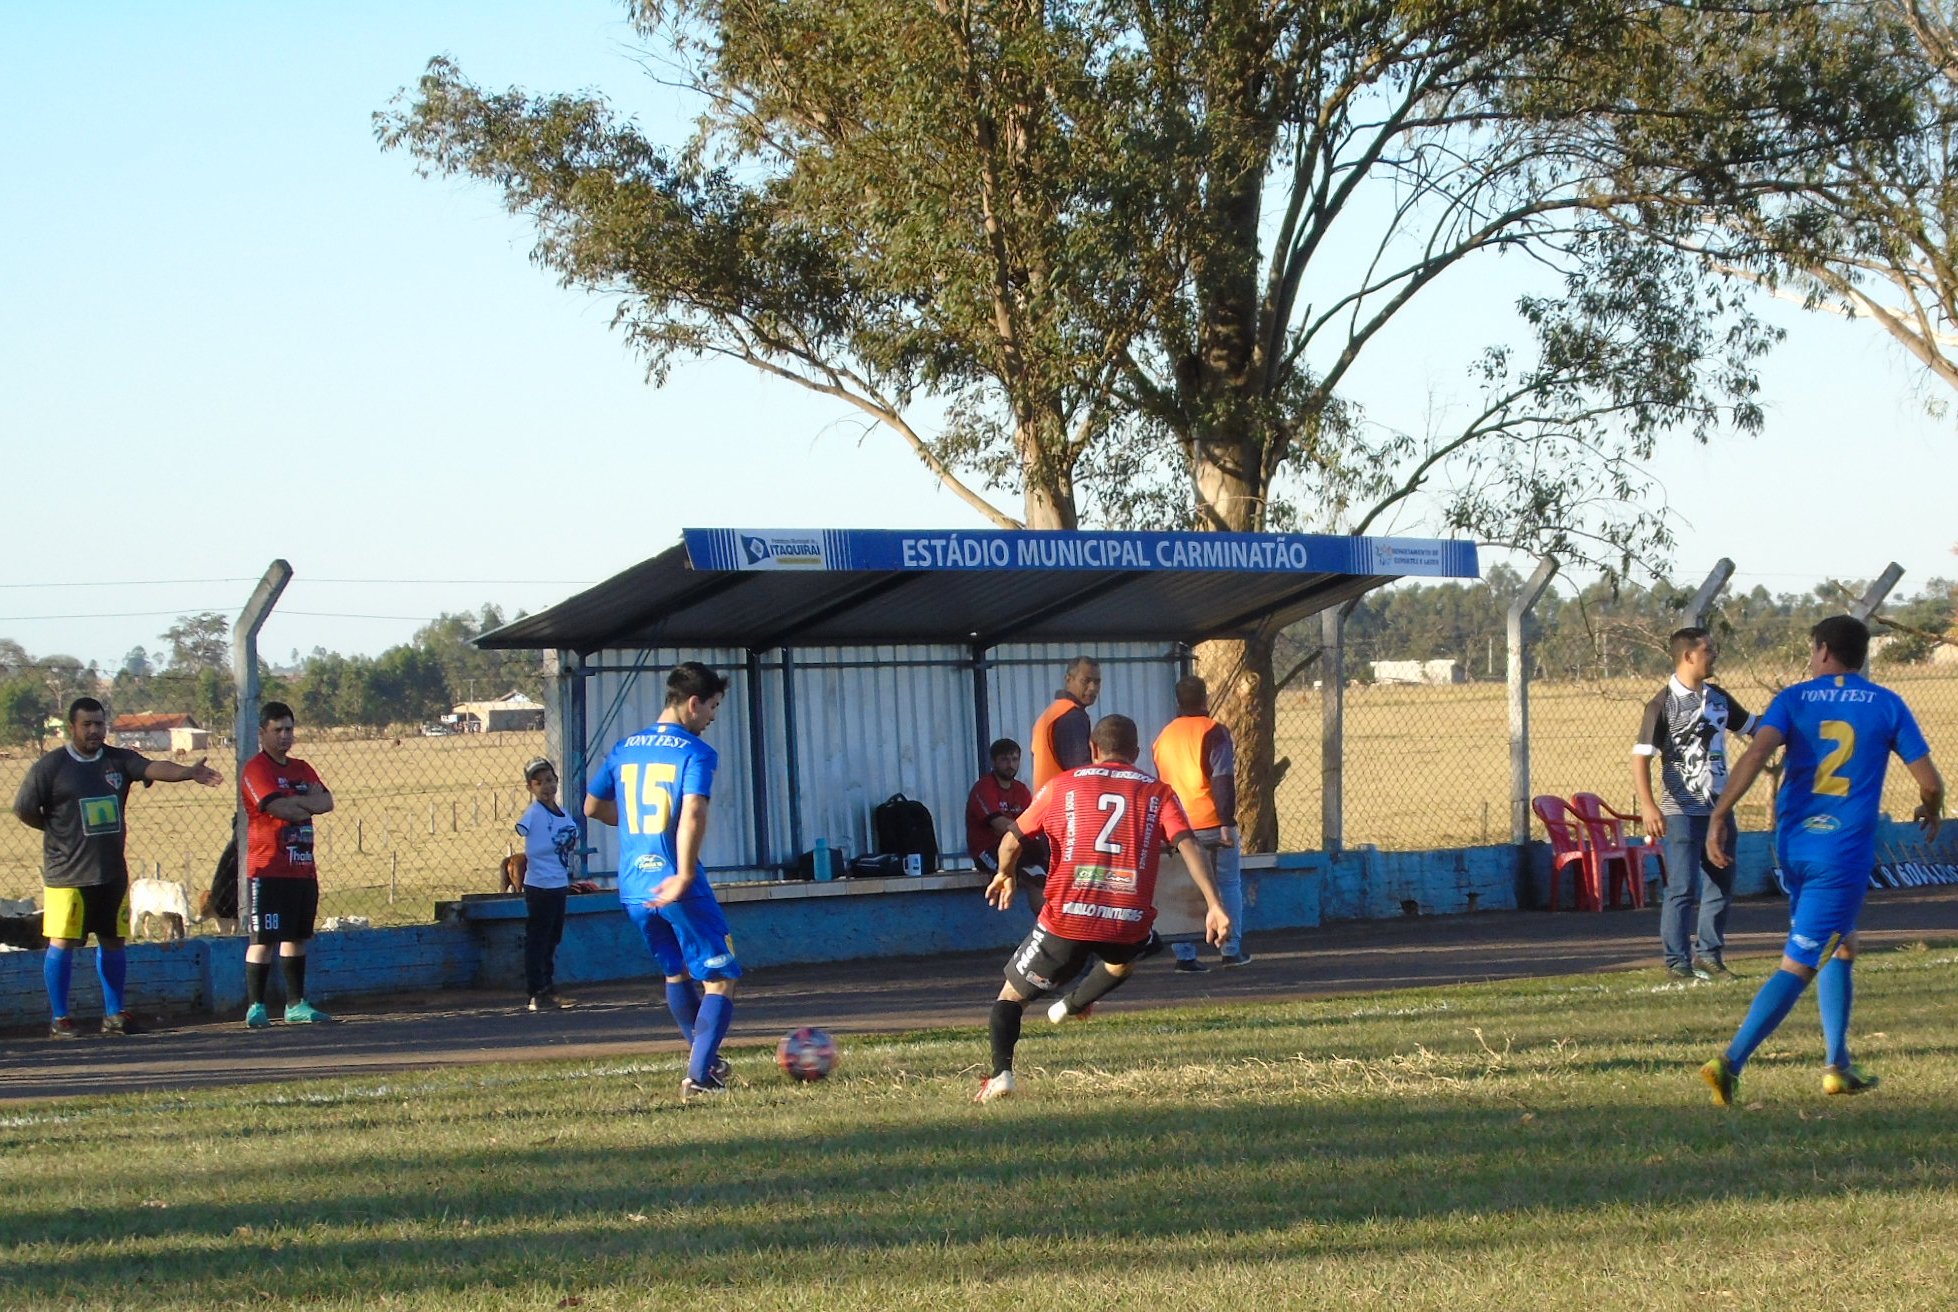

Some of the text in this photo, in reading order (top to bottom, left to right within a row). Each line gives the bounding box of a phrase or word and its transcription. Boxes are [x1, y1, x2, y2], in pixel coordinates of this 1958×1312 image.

[902, 533, 1307, 569] ESTÁDIO MUNICIPAL CARMINATÃO
[1801, 688, 1876, 703] TONY FEST
[624, 734, 691, 749] TONY FEST
[1811, 720, 1856, 797] 2
[620, 763, 676, 835] 15
[1094, 792, 1127, 854] 2
